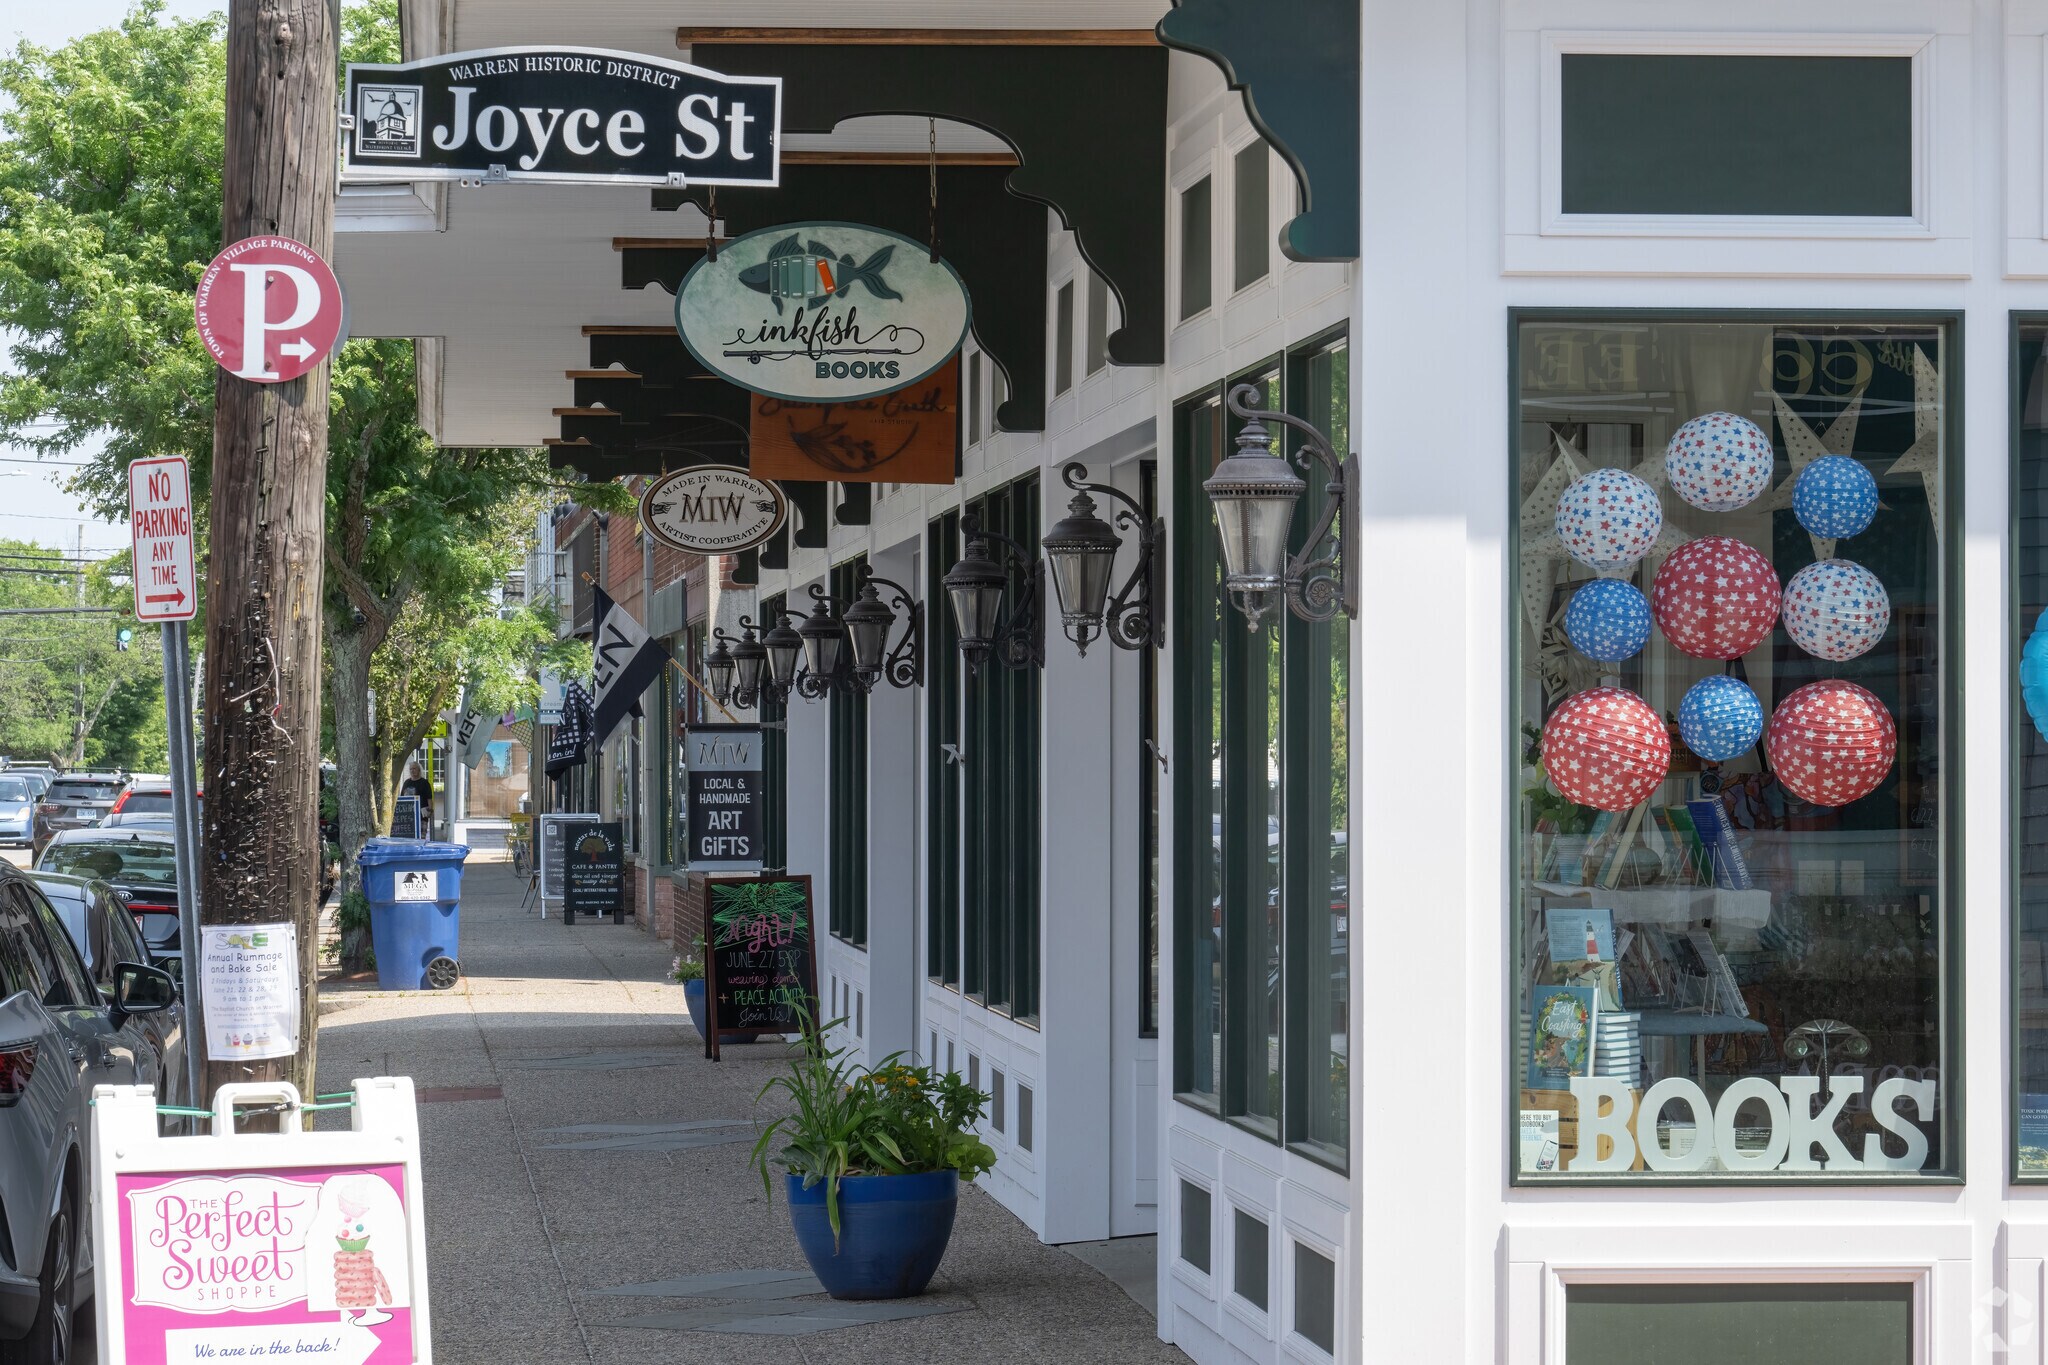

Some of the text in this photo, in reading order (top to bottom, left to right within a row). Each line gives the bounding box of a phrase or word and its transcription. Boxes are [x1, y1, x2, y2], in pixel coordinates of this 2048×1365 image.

[448, 58, 681, 90] WARREN HISTORIC DISTRICT
[432, 86, 755, 171] Joyce St
[199, 239, 316, 359] TOWN OF WARREN VILLAGE PARKING
[230, 263, 321, 380] P
[815, 361, 900, 379] BOOKS
[148, 472, 171, 502] NO
[662, 475, 764, 497] MADE IN WARREN
[679, 484, 746, 526] MIW
[135, 506, 187, 539] PARKING
[659, 517, 769, 545] ARTIST COOPERATIVE
[152, 541, 174, 562] ANY
[151, 565, 178, 586] TIME
[704, 778, 746, 789] LOCAL &
[699, 793, 751, 804] HANDMADE
[708, 811, 743, 830] ART
[575, 832, 588, 851] nectar
[589, 828, 597, 836] de
[598, 830, 604, 838] la
[724, 911, 797, 953] Night!
[207, 952, 283, 963] Annual Rummage
[726, 951, 757, 968] JUNE
[211, 963, 277, 974] and Bake Sale
[728, 971, 769, 990] weaving
[734, 989, 767, 1005] PEACE
[1552, 1000, 1577, 1015] East
[738, 1007, 767, 1028] Join
[1541, 1016, 1583, 1038] Coasting
[1568, 1075, 1936, 1172] BOOKS
[189, 1199, 218, 1209] THE
[150, 1191, 305, 1251] Perfect
[163, 1236, 306, 1290] Sweet
[197, 1285, 276, 1300] SHOPPE
[195, 1337, 341, 1358] We are in the back!
